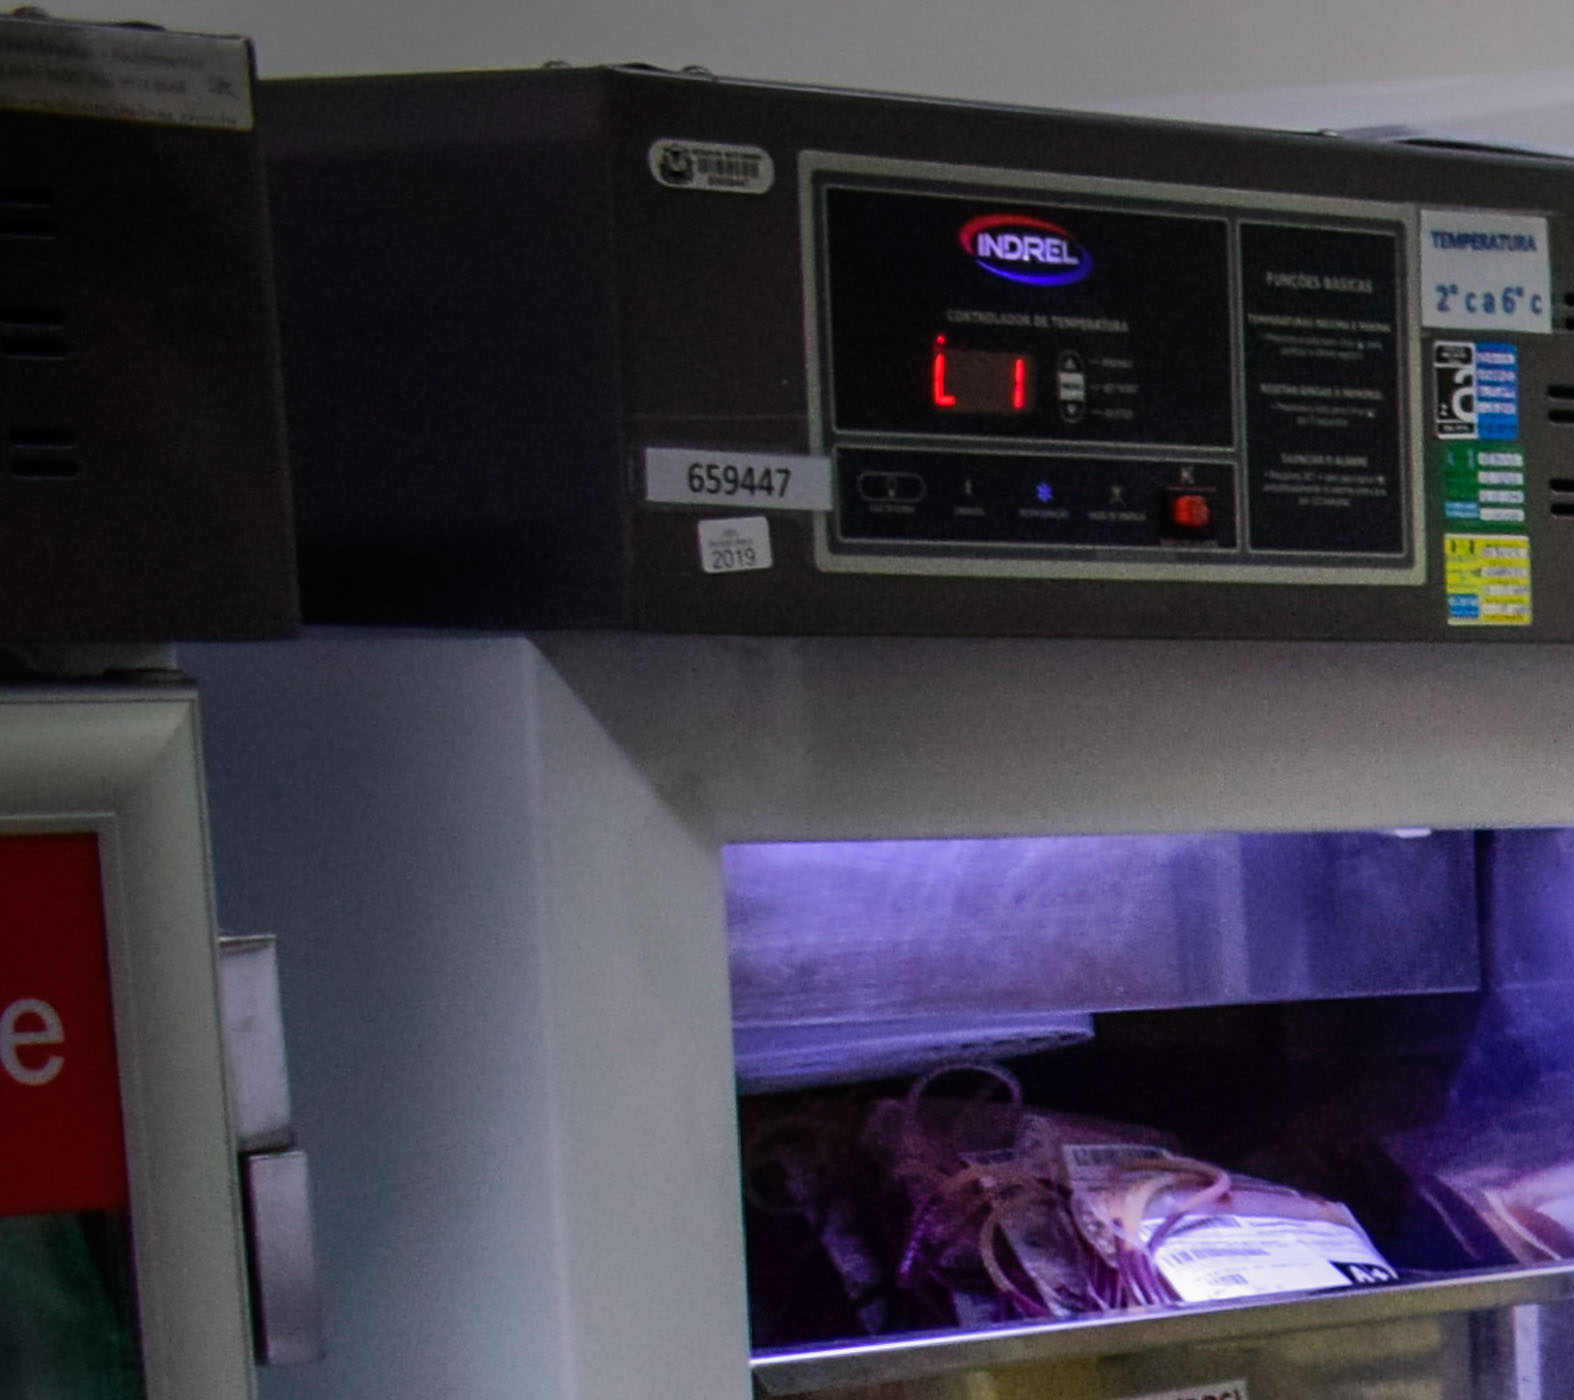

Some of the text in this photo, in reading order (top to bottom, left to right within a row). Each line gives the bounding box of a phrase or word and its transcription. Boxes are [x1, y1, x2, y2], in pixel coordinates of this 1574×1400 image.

[977, 233, 1080, 266] INDREL
[1431, 229, 1537, 253] TEMPERATURA
[687, 462, 792, 499] 659447
[711, 547, 757, 569] 2019
